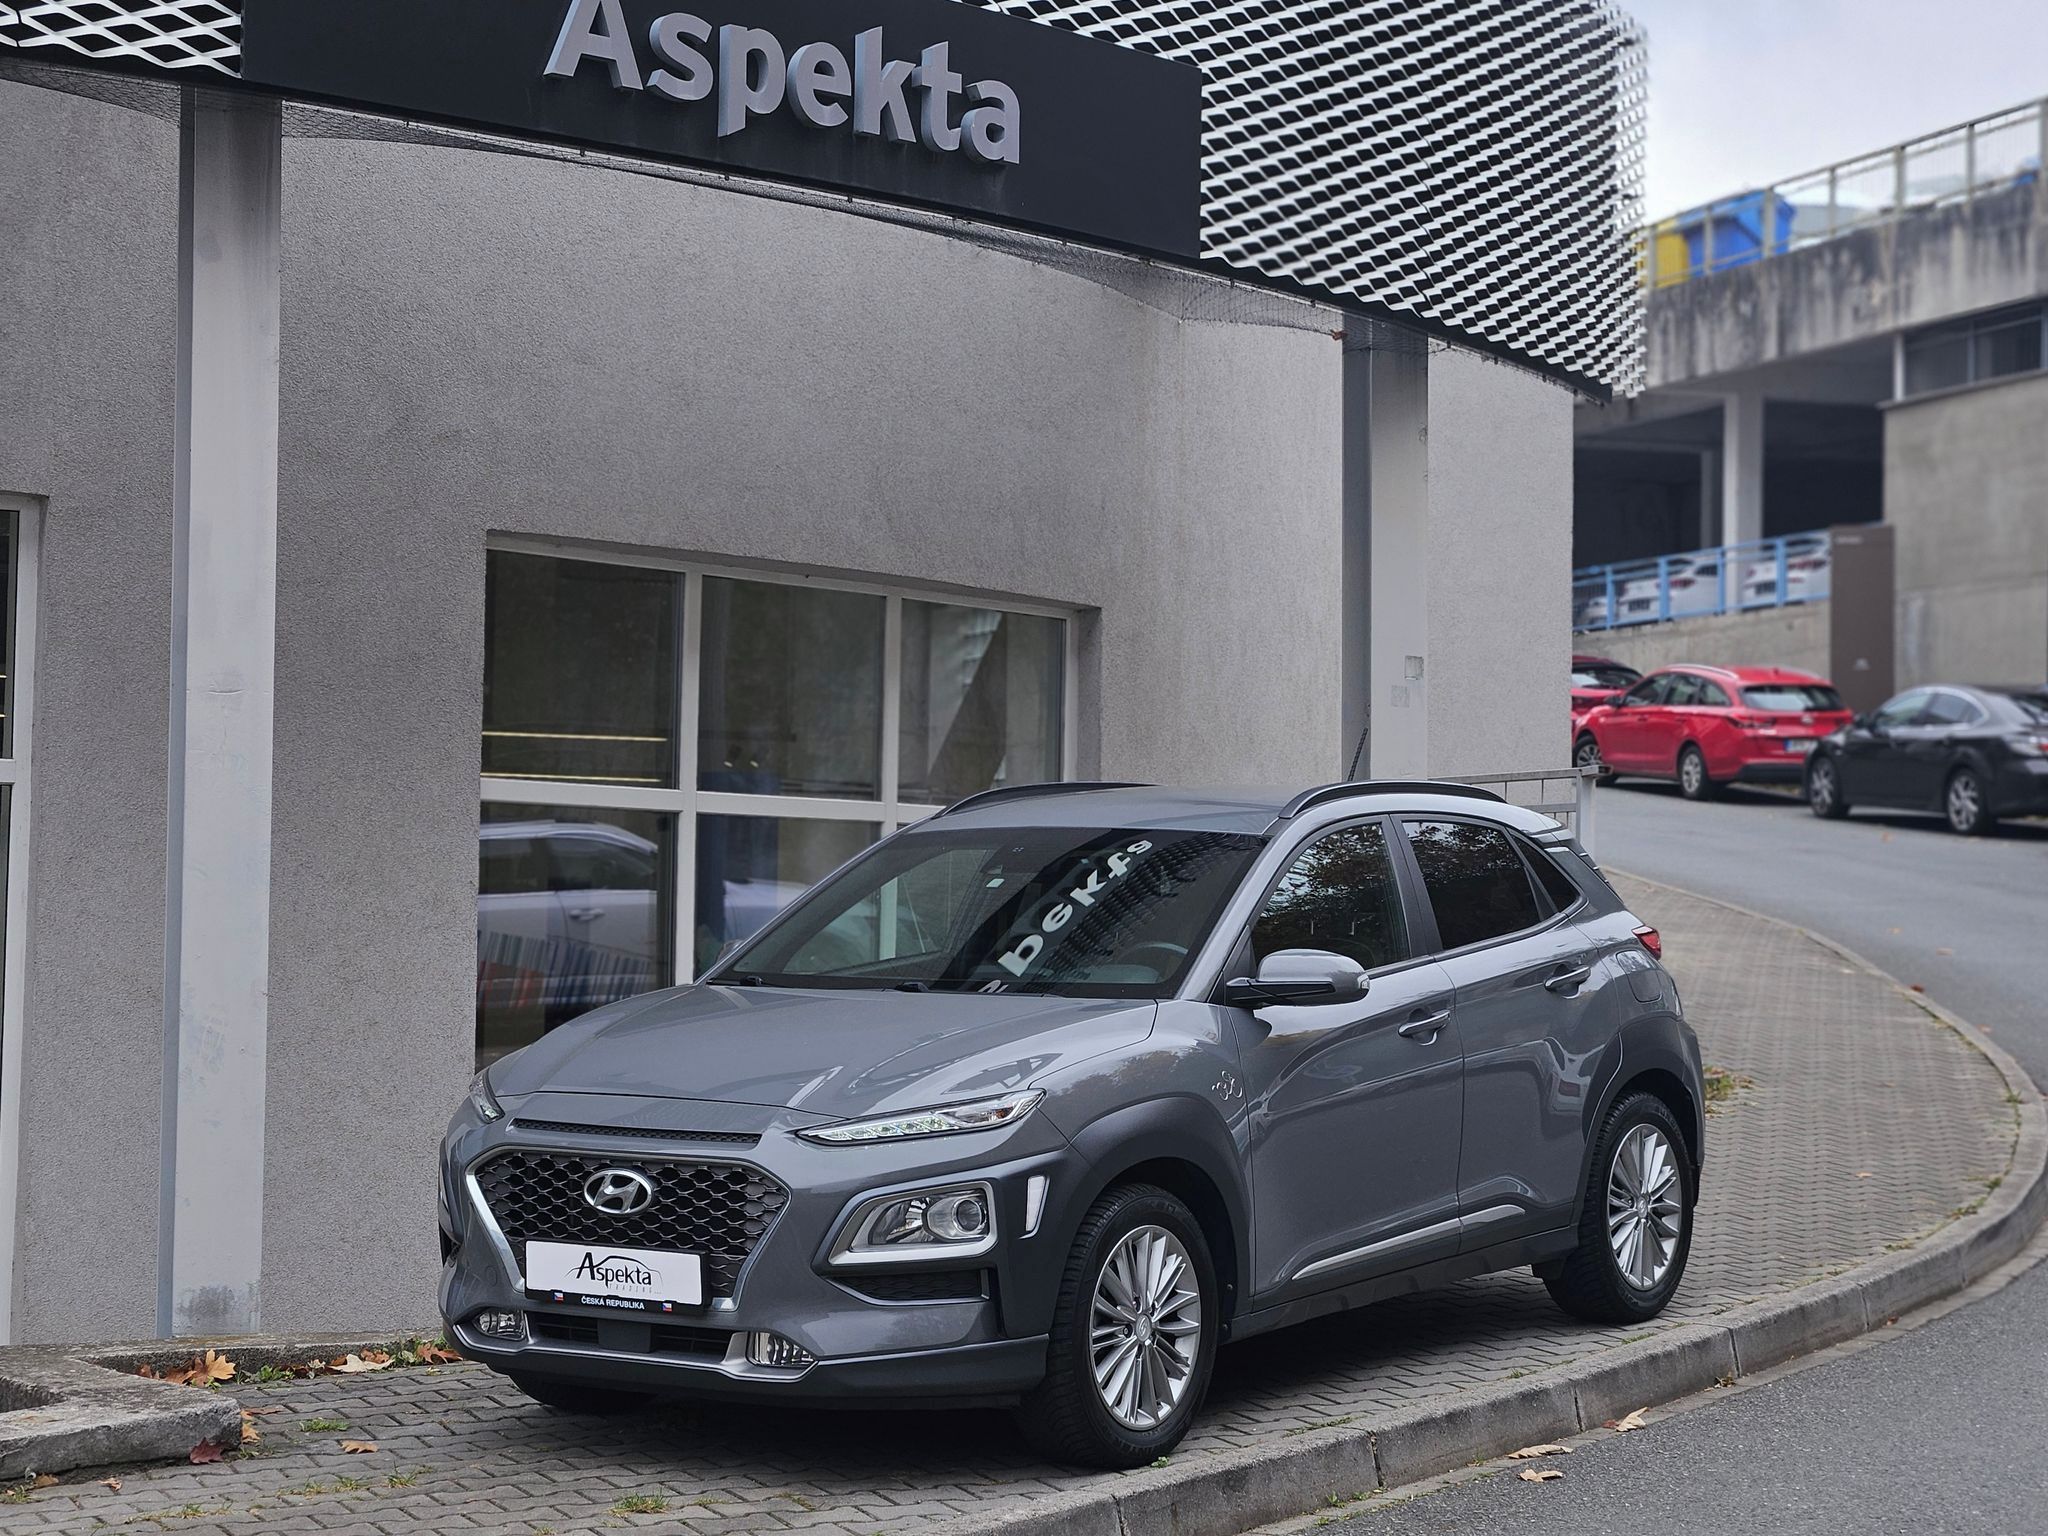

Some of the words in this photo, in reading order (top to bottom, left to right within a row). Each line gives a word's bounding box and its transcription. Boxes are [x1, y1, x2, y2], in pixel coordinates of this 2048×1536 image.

[543, 0, 1020, 164] Aspekta
[576, 1252, 652, 1288] Aspekta
[581, 1295, 605, 1306] ČESKÁ
[606, 1299, 645, 1310] REPUBLIKA
